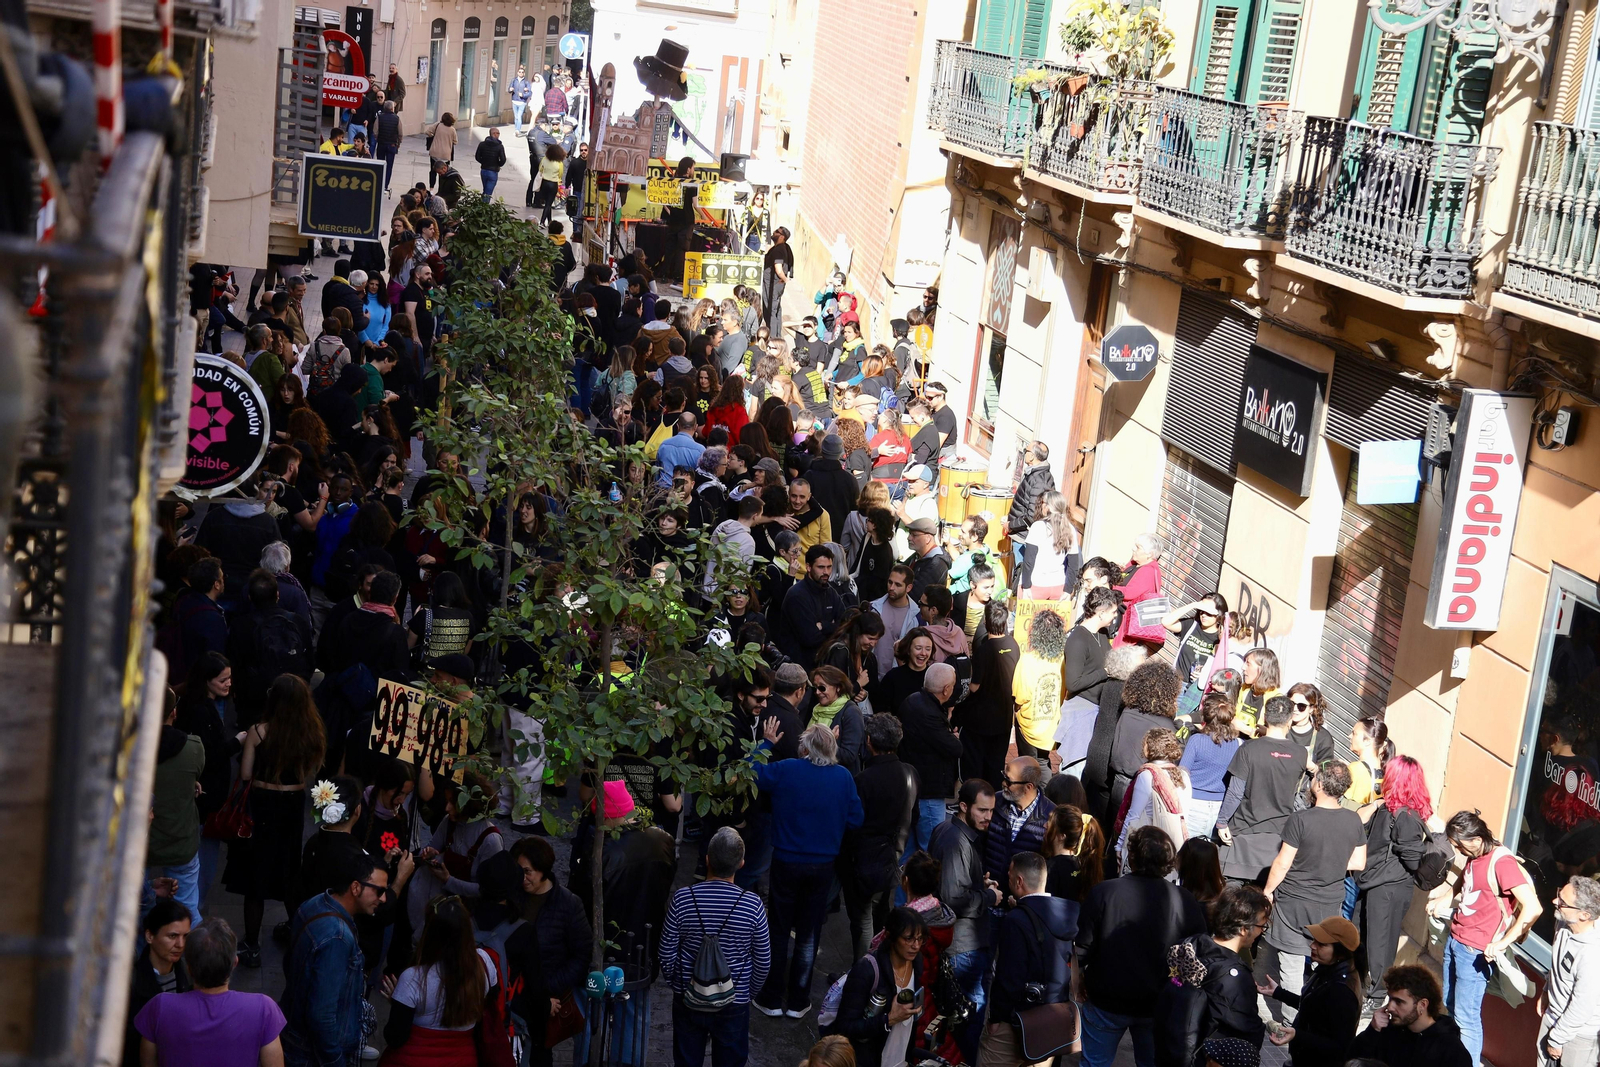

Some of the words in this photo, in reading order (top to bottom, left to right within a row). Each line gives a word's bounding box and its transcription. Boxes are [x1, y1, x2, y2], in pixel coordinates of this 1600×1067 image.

[329, 94, 358, 103] VARALES
[318, 223, 362, 235] MERCERÍA
[1125, 362, 1136, 371] 2.0
[223, 376, 241, 393] EN
[238, 391, 262, 436] COMÚN
[1478, 402, 1508, 450] bar
[1290, 431, 1305, 456] 2.0
[1447, 452, 1514, 623] indiana
[407, 690, 421, 705] SE
[1543, 750, 1565, 786] bar
